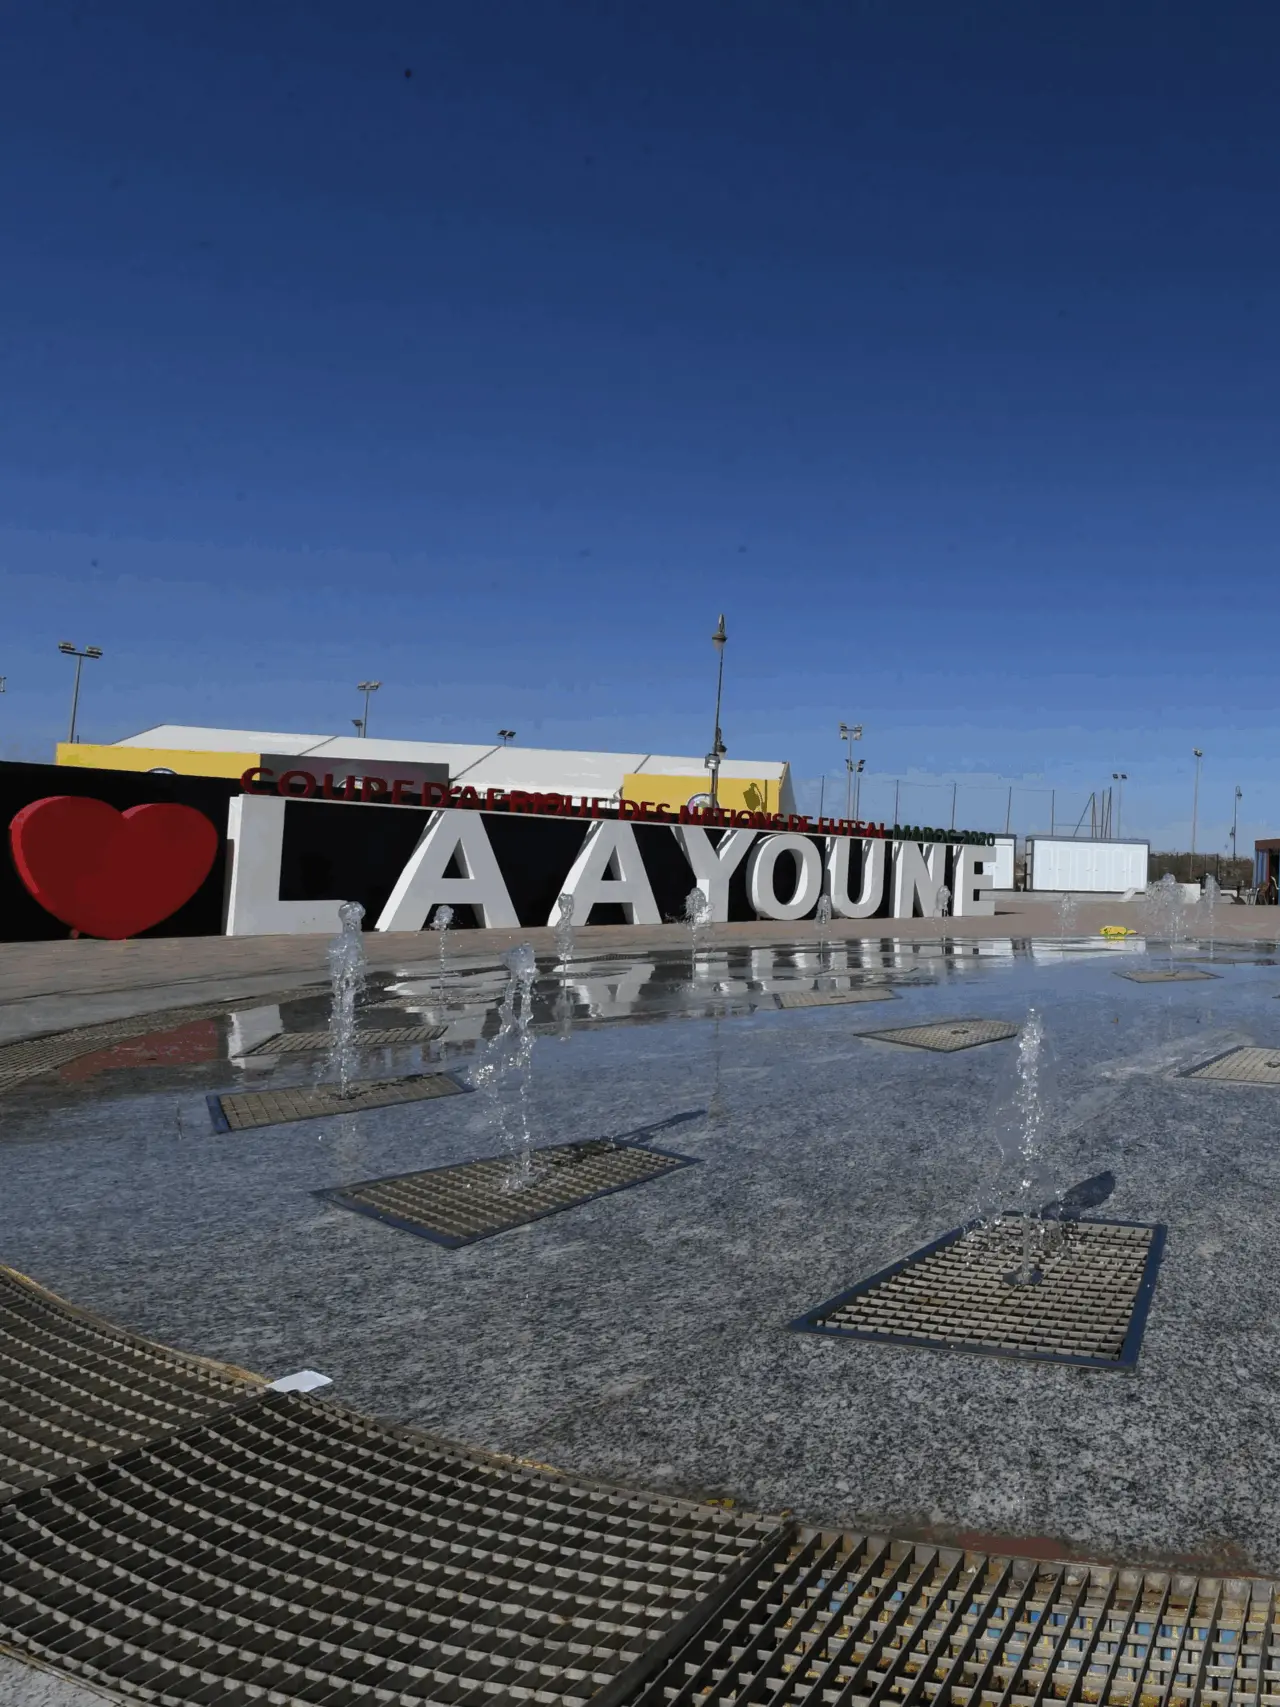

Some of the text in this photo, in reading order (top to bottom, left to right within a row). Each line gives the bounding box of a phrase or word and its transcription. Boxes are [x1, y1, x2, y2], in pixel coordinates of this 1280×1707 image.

[240, 767, 415, 805] COUPE
[618, 800, 671, 822] DES
[678, 805, 784, 831] NATIONS
[788, 814, 813, 832] DE
[818, 817, 885, 839] FUTSAL
[225, 793, 996, 936] LAAYOUNE
